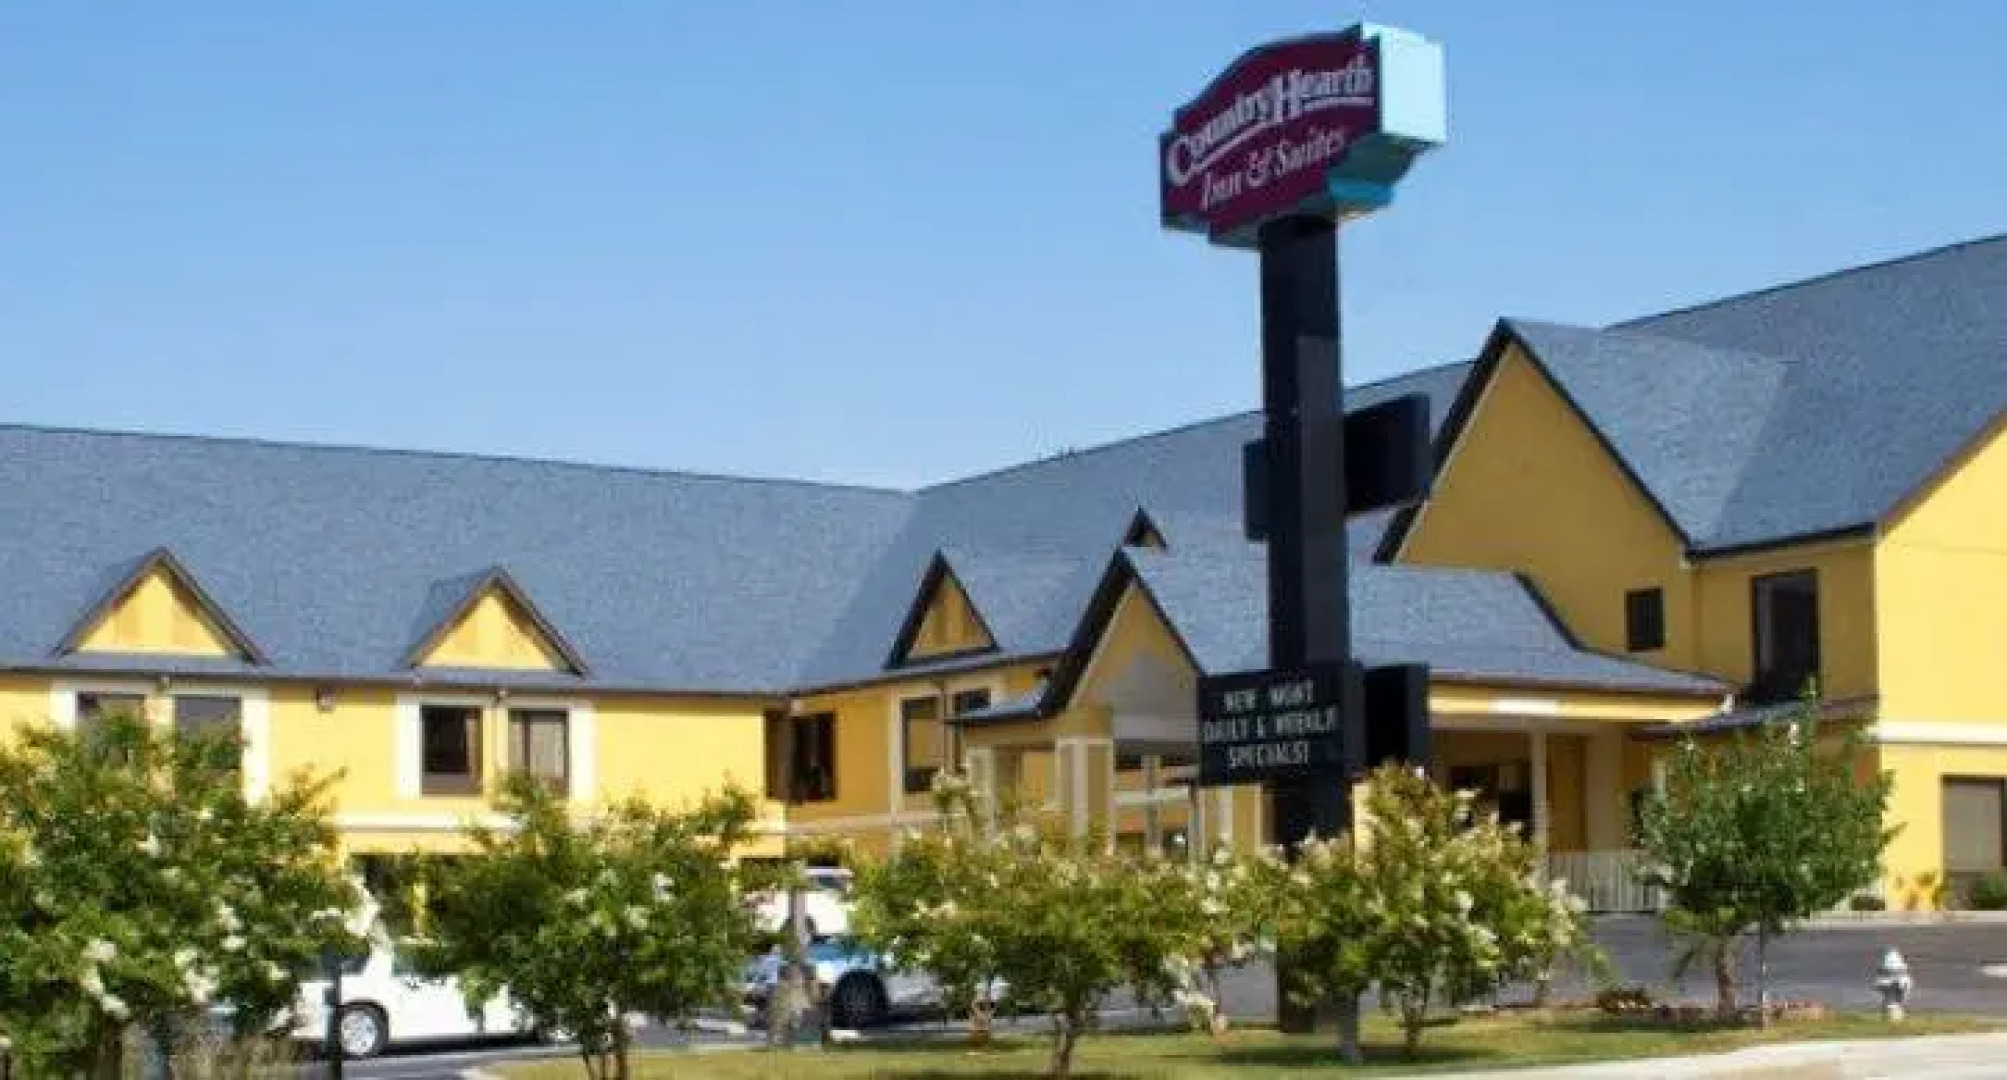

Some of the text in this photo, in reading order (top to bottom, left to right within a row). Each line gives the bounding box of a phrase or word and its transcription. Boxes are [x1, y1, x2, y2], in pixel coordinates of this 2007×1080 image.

[1201, 125, 1346, 210] Inn & Suites
[1223, 689, 1256, 712] NEW
[1203, 717, 1249, 742] DAILY
